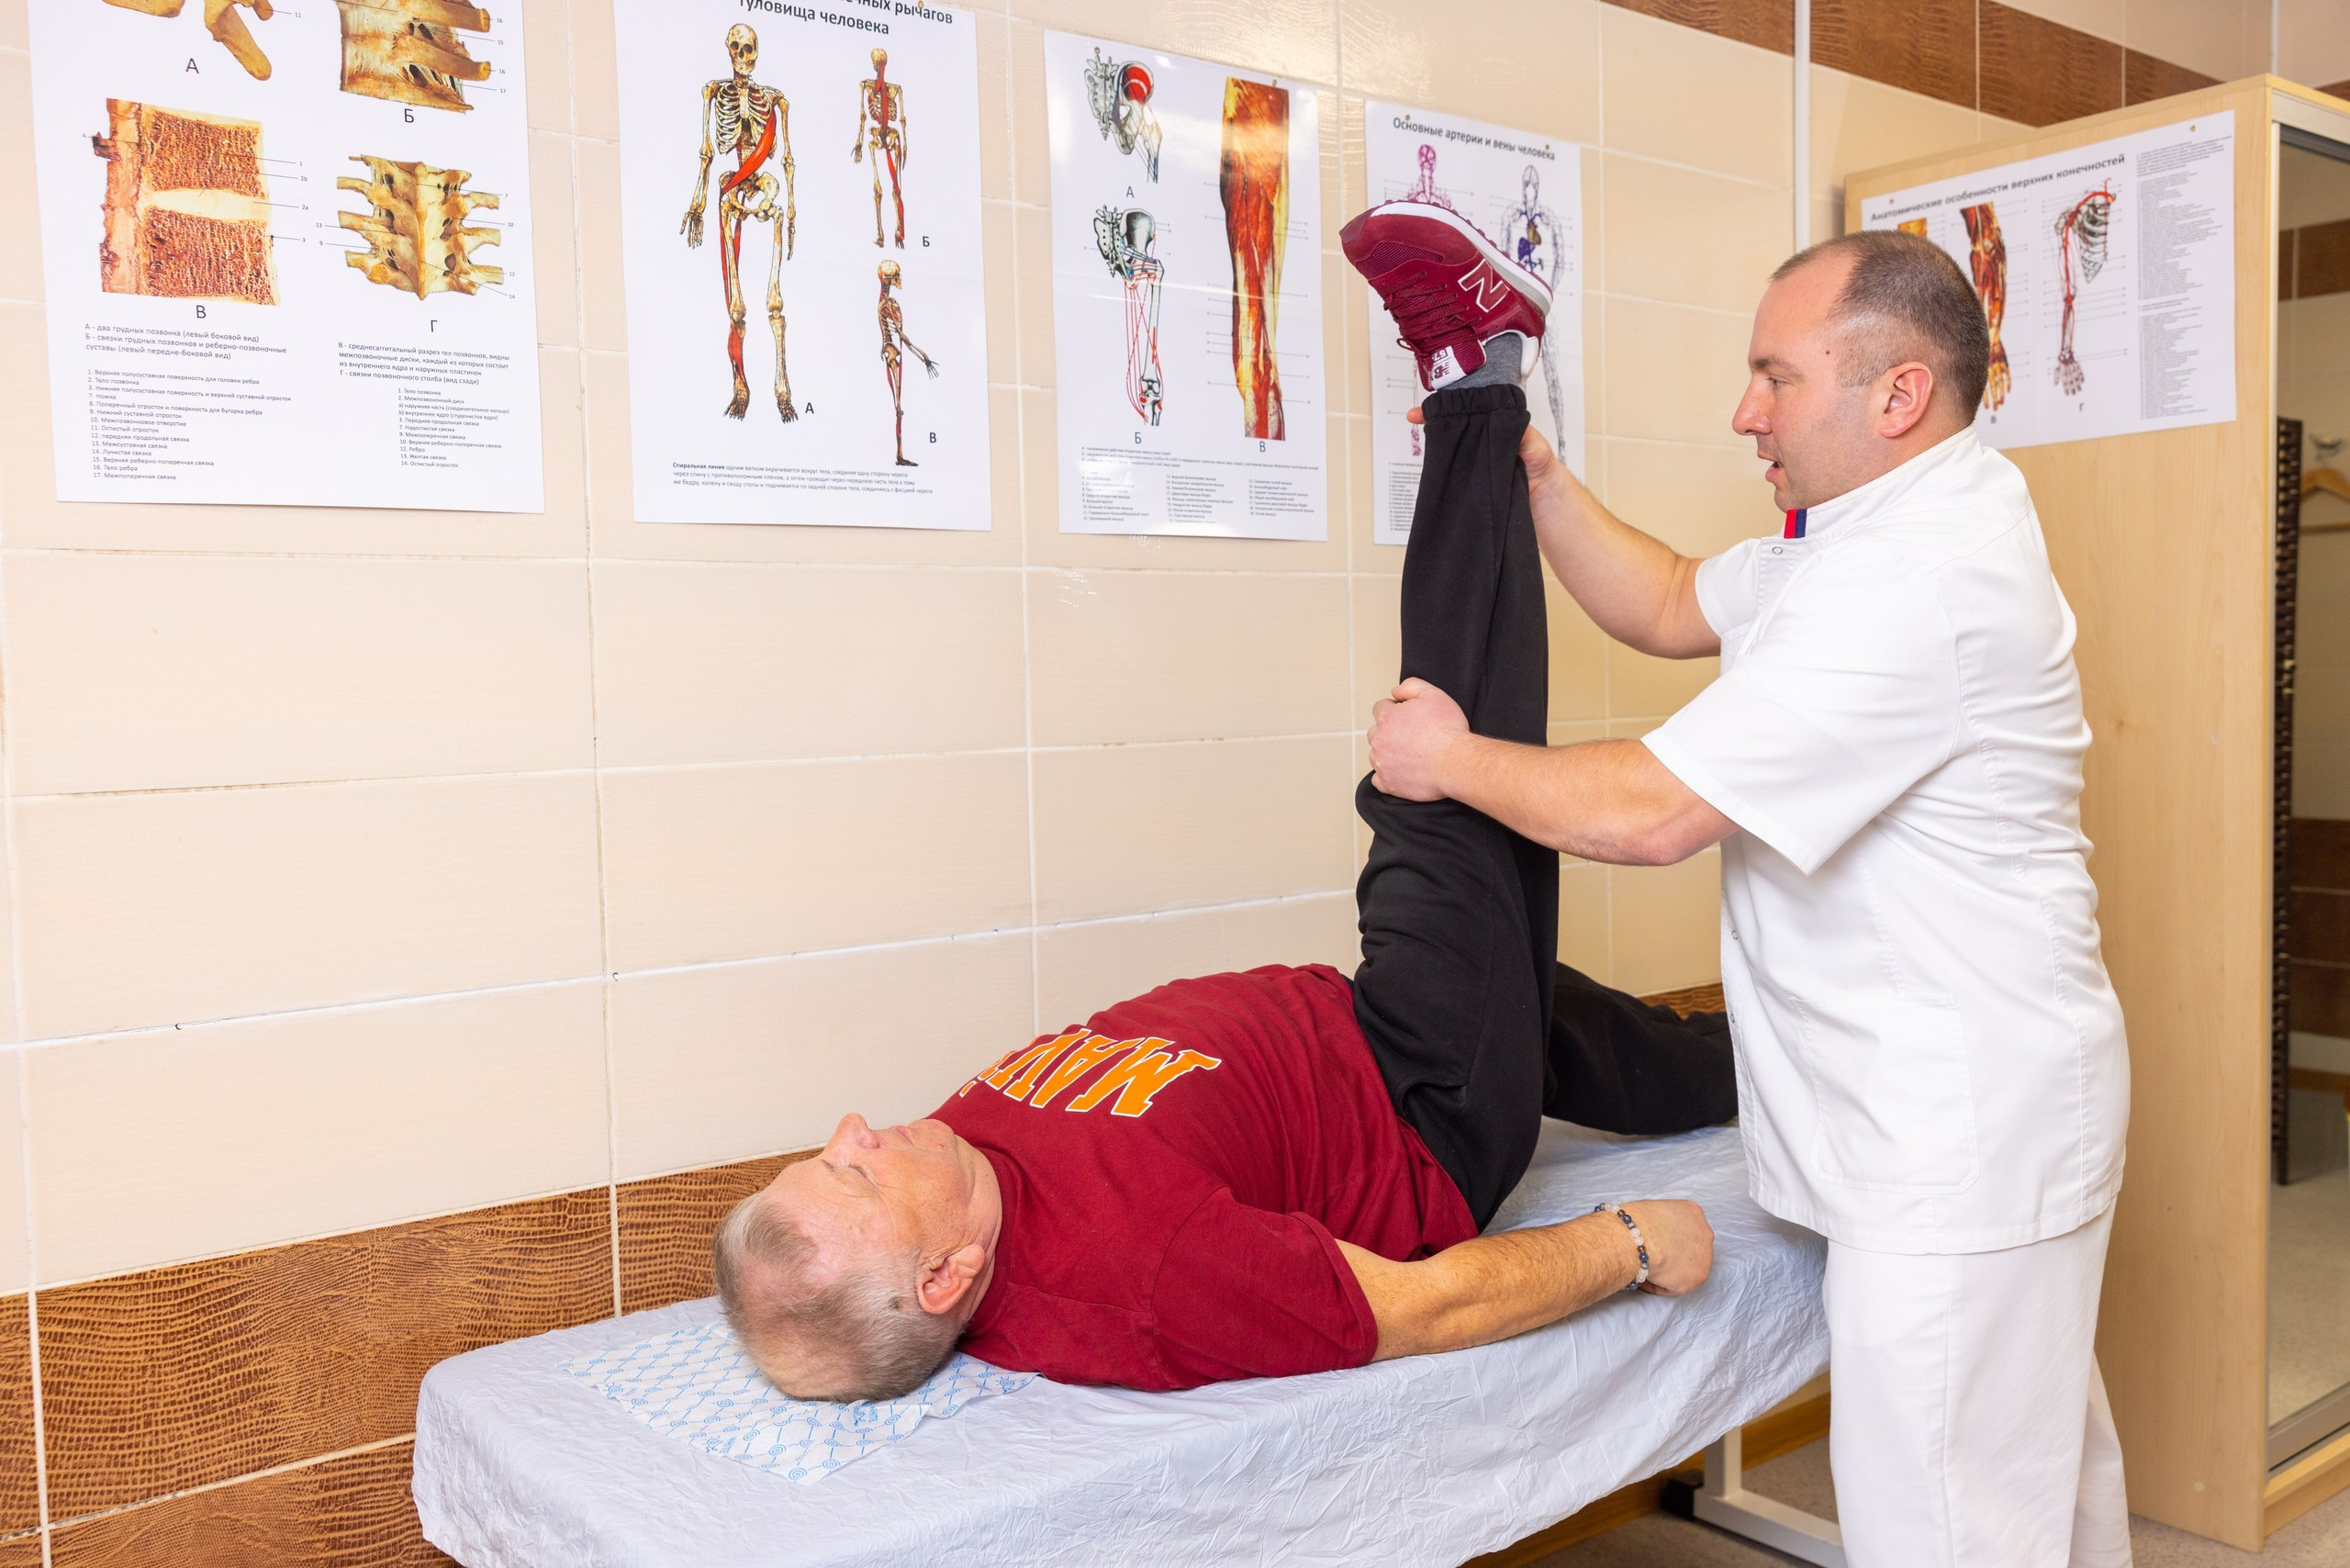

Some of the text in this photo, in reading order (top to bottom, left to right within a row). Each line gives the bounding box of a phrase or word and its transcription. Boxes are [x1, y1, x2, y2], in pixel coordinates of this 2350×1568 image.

[895, 2, 953, 24] рычагов
[821, 11, 889, 34] человека
[185, 57, 200, 74] А
[405, 108, 414, 123] Б
[1393, 118, 1443, 137] Основные
[1446, 129, 1483, 145] артерии
[1494, 140, 1516, 151] вены
[1517, 145, 1555, 160] человека
[1125, 185, 1135, 198] А
[1871, 198, 1943, 221] Анатомические
[1945, 183, 2009, 205] особенности
[2010, 174, 2053, 190] верхних
[2056, 155, 2126, 178] конечностей
[923, 236, 930, 248] Б
[1458, 259, 1510, 312] N
[196, 305, 207, 319] В
[431, 320, 437, 332] Г
[183, 330, 209, 339] (левый
[210, 332, 242, 341] боковой
[243, 335, 260, 343] вид)
[118, 344, 146, 353] (левый
[215, 352, 231, 360] вид)
[453, 352, 488, 360] позвонков,
[443, 376, 458, 385] (вид
[804, 402, 814, 414] А
[929, 431, 936, 443] В
[1135, 431, 1141, 444] Б
[1259, 441, 1266, 453] В
